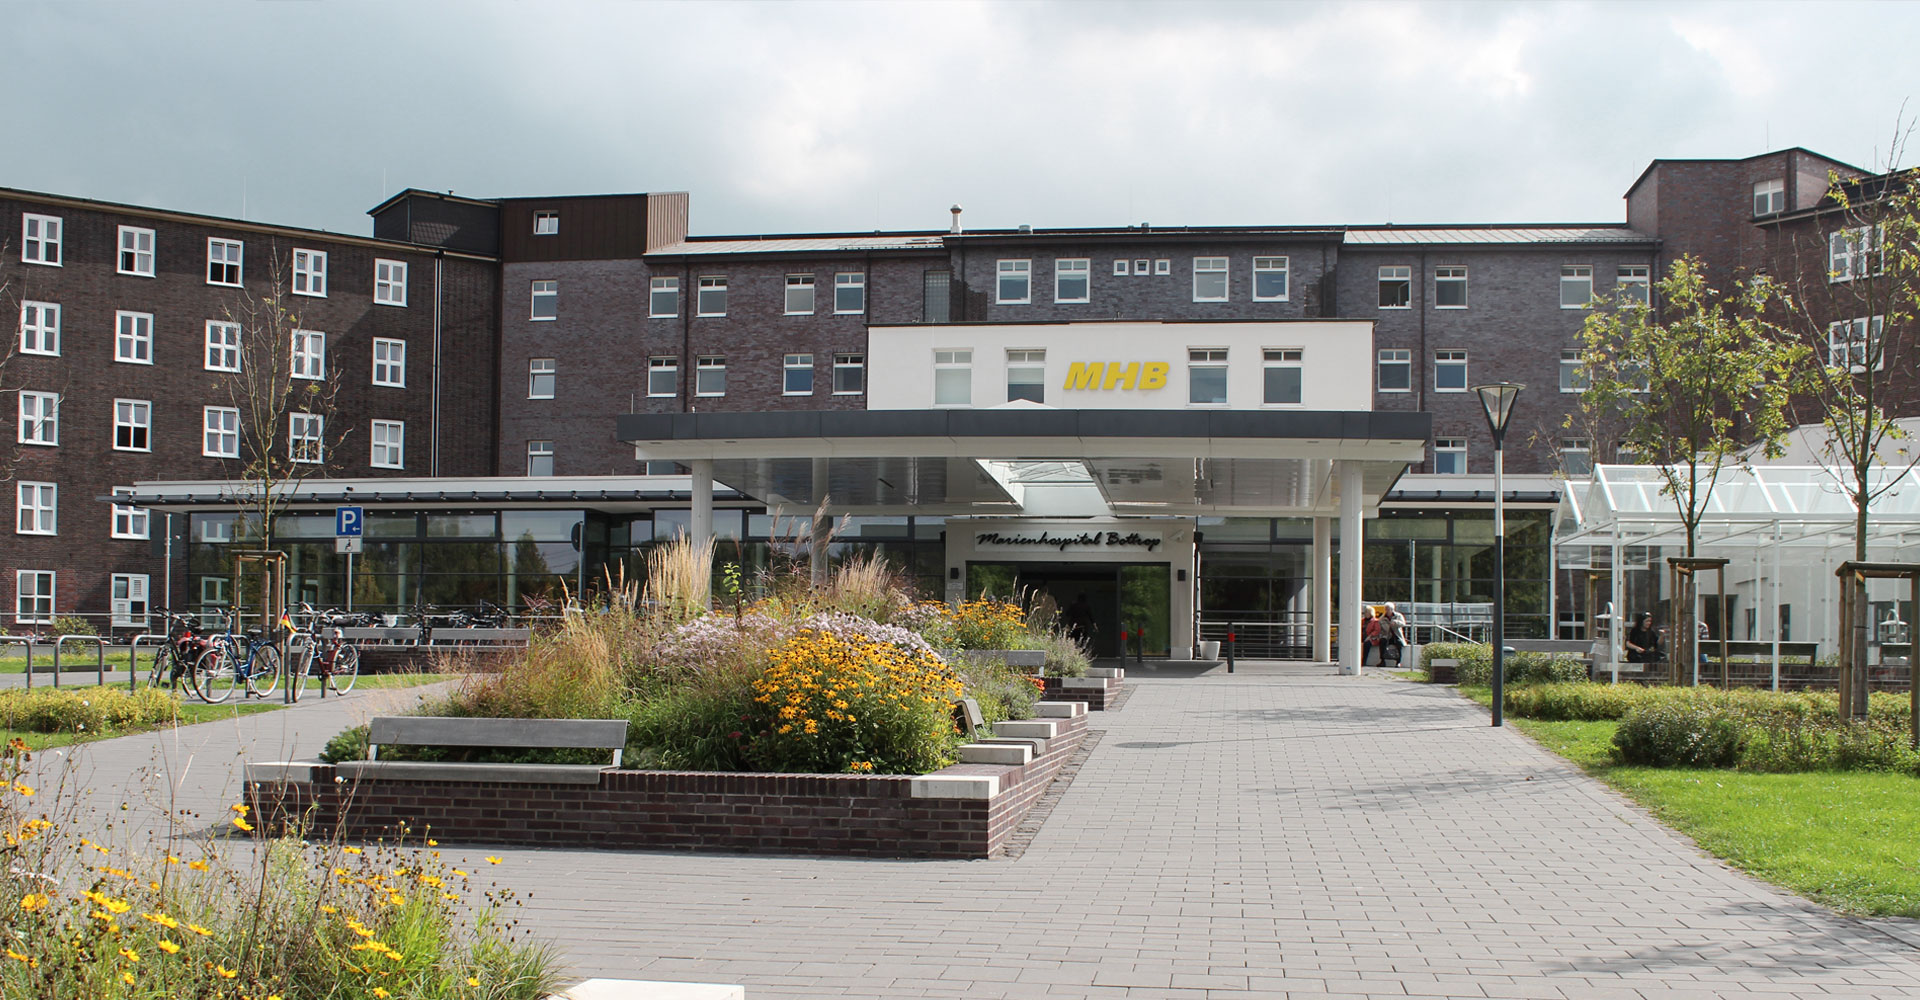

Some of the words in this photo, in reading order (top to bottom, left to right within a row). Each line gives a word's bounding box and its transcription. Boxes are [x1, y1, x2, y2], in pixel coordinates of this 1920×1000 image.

[1063, 361, 1170, 390] MHB
[342, 510, 357, 533] P
[976, 531, 1102, 551] Marienhospital
[1105, 531, 1161, 552] Bottrop
